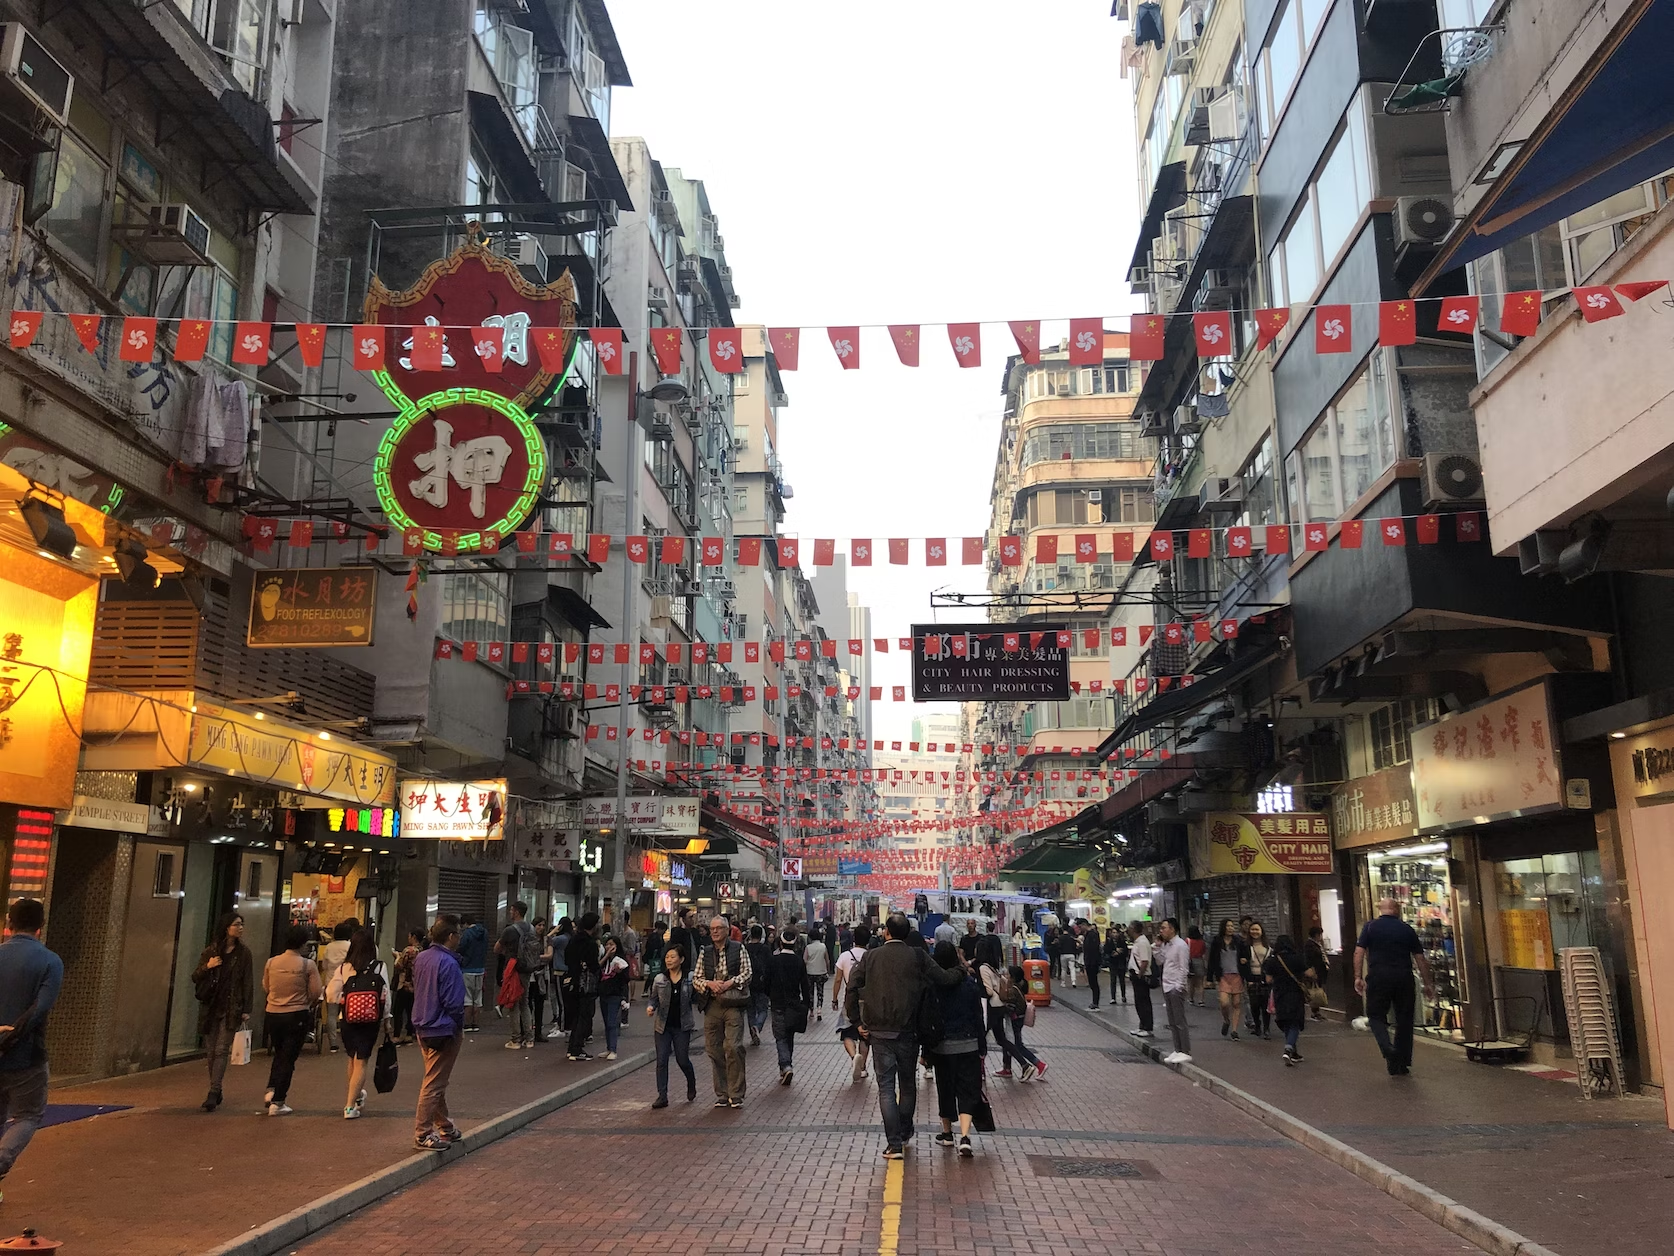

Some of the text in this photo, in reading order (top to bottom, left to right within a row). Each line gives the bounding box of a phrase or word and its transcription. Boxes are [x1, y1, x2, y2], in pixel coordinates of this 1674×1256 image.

[408, 419, 512, 519] 押
[283, 575, 368, 604] 水月坊
[277, 608, 367, 620] FOOT REFLEXOLOGY
[922, 667, 1060, 677] CITY HAIR DRESSING
[922, 683, 1054, 693] & BEAUTY PRODUCTS
[206, 724, 293, 766] MING SANG PAWN SHOP
[74, 805, 147, 825] TEMPLE STREET
[403, 822, 498, 831] MING SANG PAWN SHP
[1259, 818, 1328, 835] 美髮用品
[1210, 819, 1260, 872] 都市
[1269, 843, 1330, 854] CITY HAIR
